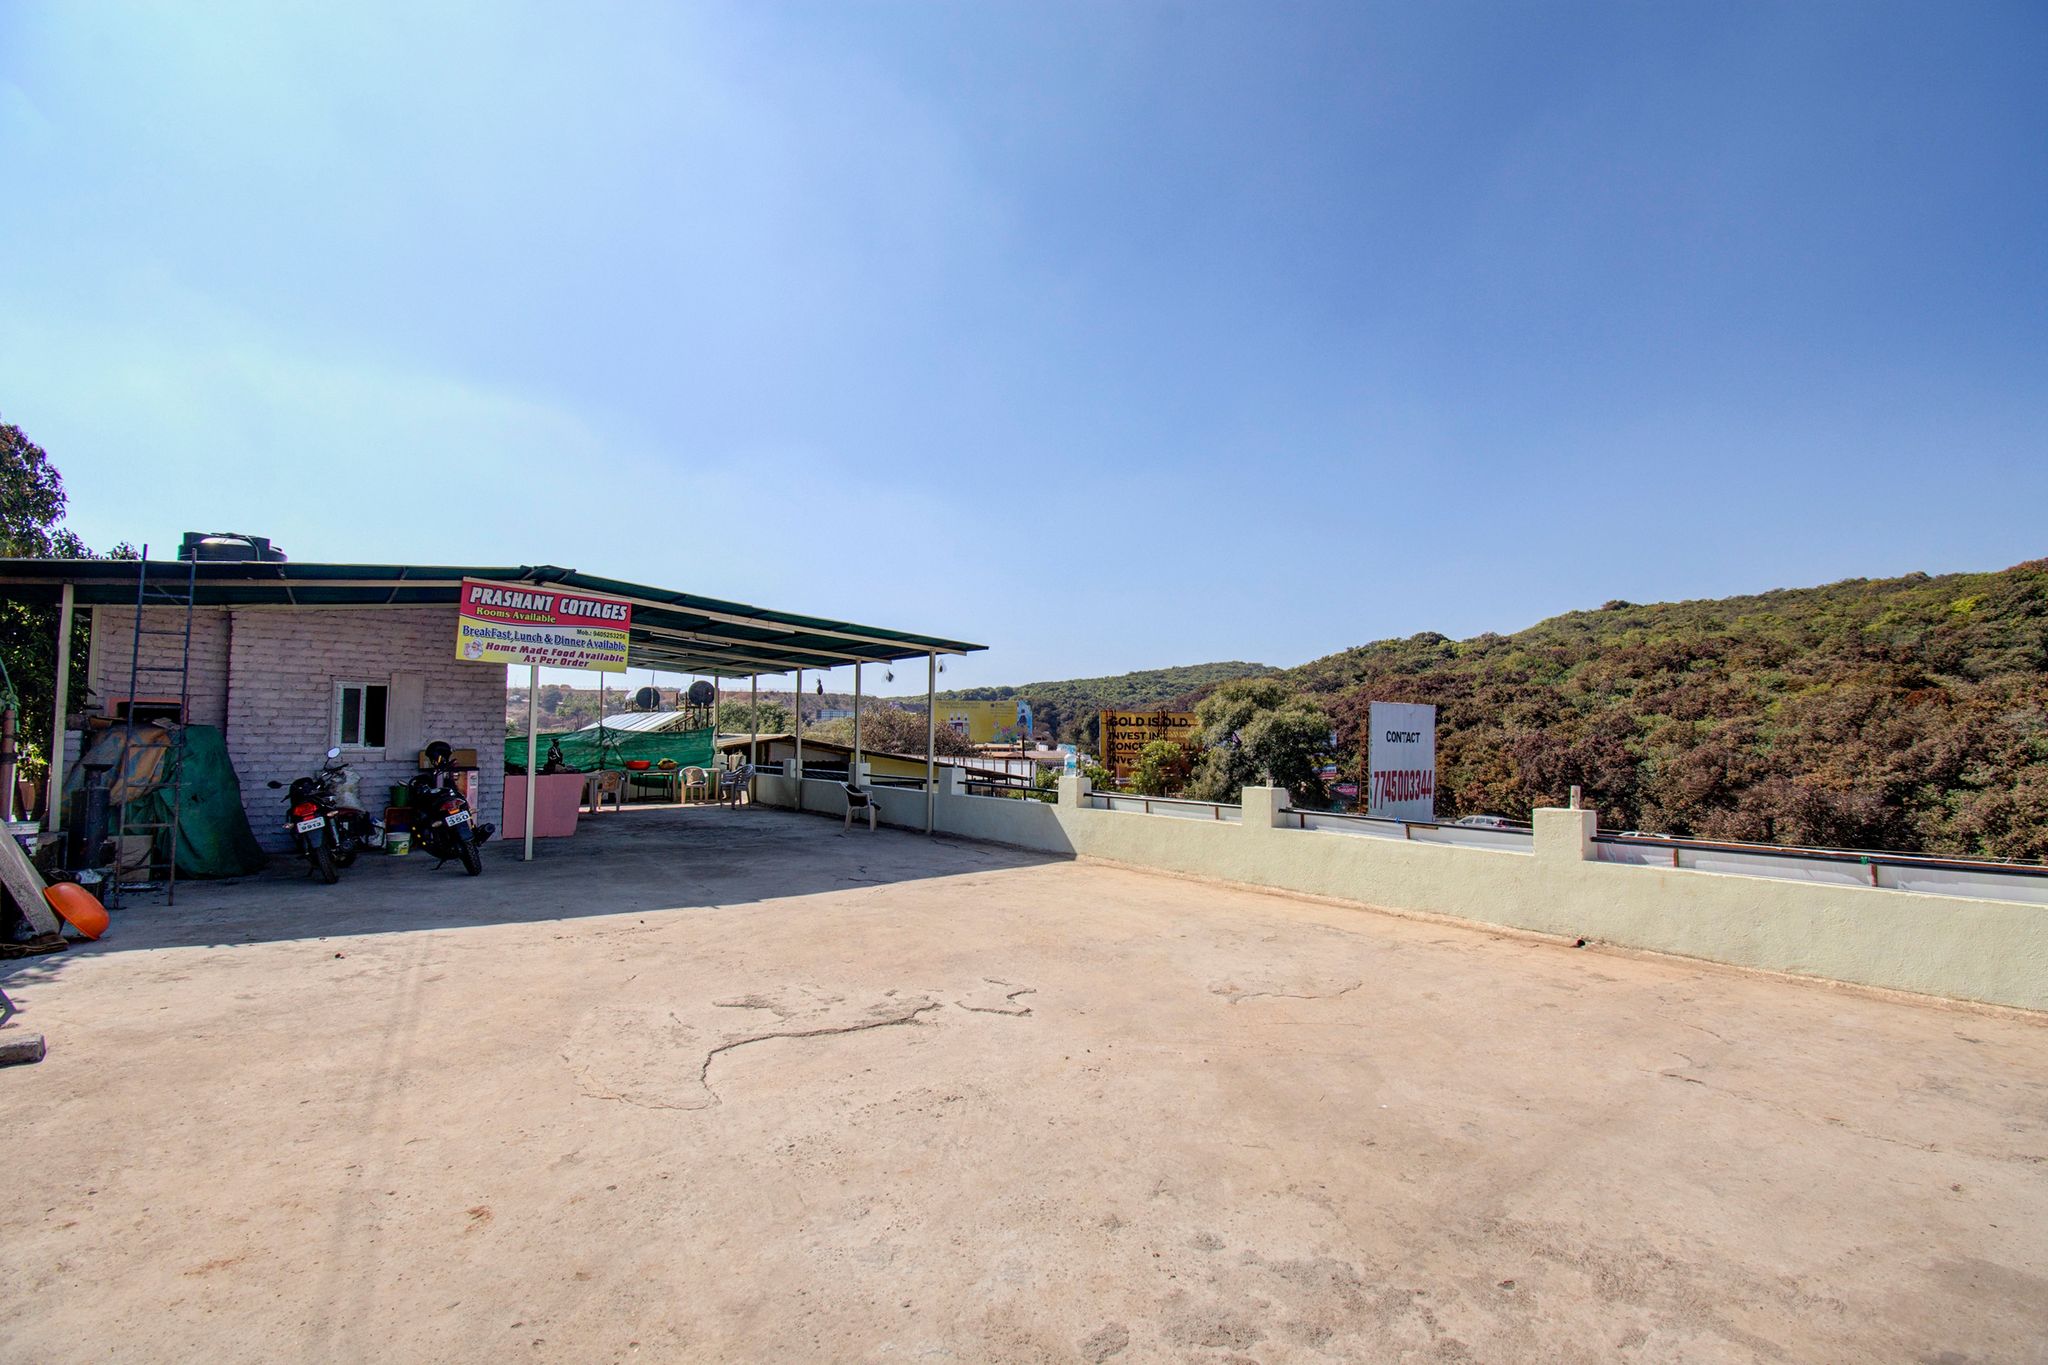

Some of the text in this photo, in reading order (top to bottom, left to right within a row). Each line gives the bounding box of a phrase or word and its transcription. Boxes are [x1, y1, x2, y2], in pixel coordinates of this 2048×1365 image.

[469, 586, 628, 621] PRASHANT COTTAGES
[476, 606, 556, 624] Rooms Available
[544, 633, 553, 644] &
[554, 634, 586, 648] Dinner
[587, 638, 626, 652] Available
[486, 642, 625, 663] Home Made Food Available
[523, 655, 590, 669] As Per Order
[1109, 716, 1145, 727] GOLD
[1147, 717, 1159, 727] IS
[1108, 731, 1147, 740] INVEST
[1386, 730, 1421, 743] CONTACT
[1373, 769, 1433, 810] 7745003344
